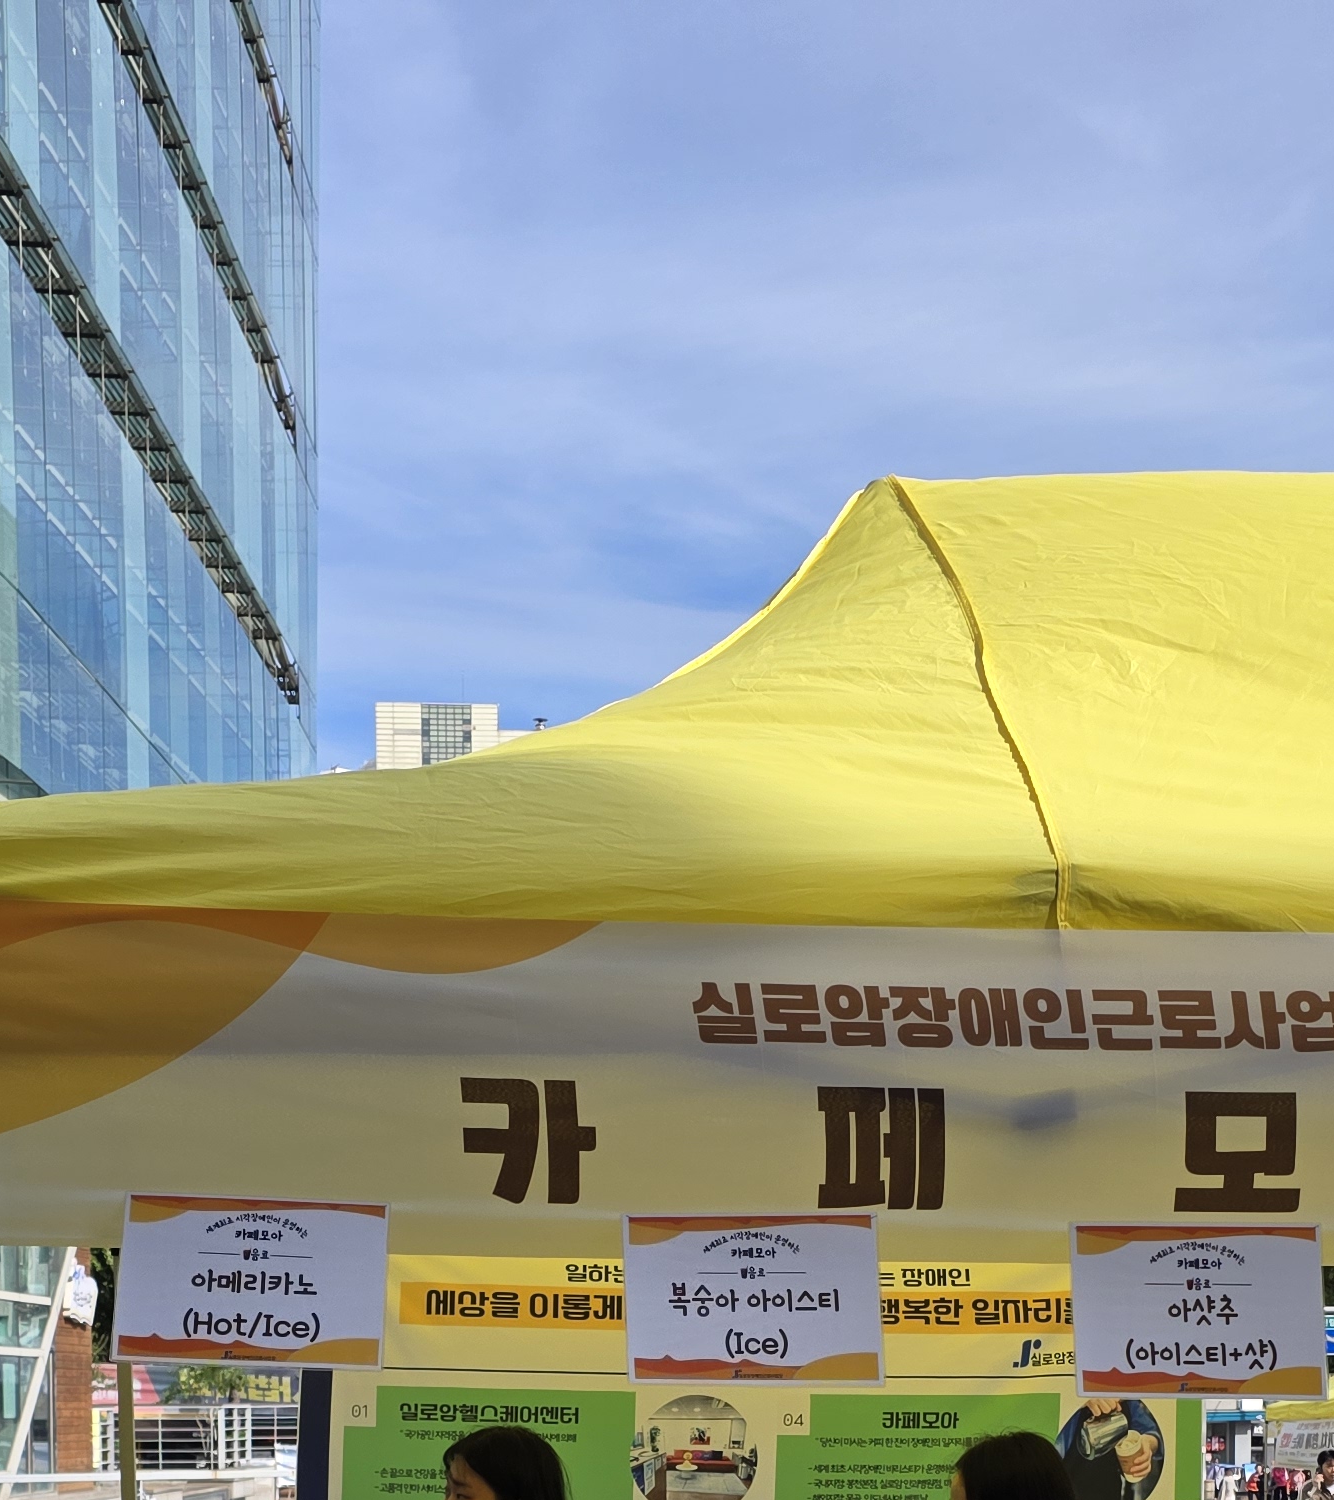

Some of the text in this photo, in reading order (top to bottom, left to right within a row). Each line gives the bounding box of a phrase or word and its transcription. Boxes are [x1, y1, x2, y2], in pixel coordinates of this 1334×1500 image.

[235, 1229, 284, 1242] 카페모아
[731, 1247, 776, 1260] 카페모아
[1177, 1258, 1222, 1270] 카페모아
[191, 1269, 318, 1296] 아메리카노
[900, 1268, 972, 1288] 장애인
[424, 1289, 521, 1320] 세상을
[528, 1291, 623, 1323] 이롭게
[881, 1299, 963, 1326] 행복한
[668, 1282, 840, 1317] 복숭아 아이스티
[1168, 1294, 1239, 1326] 아샷추
[182, 1308, 321, 1343] (Hot/Ice)
[725, 1328, 789, 1359] (Ice)
[1125, 1338, 1278, 1371] (아이스티+샷)
[351, 1404, 368, 1418] 01
[400, 1403, 579, 1424] 실로암헬스케어센터
[783, 1413, 804, 1426] 04
[882, 1412, 959, 1429] 카페모아
